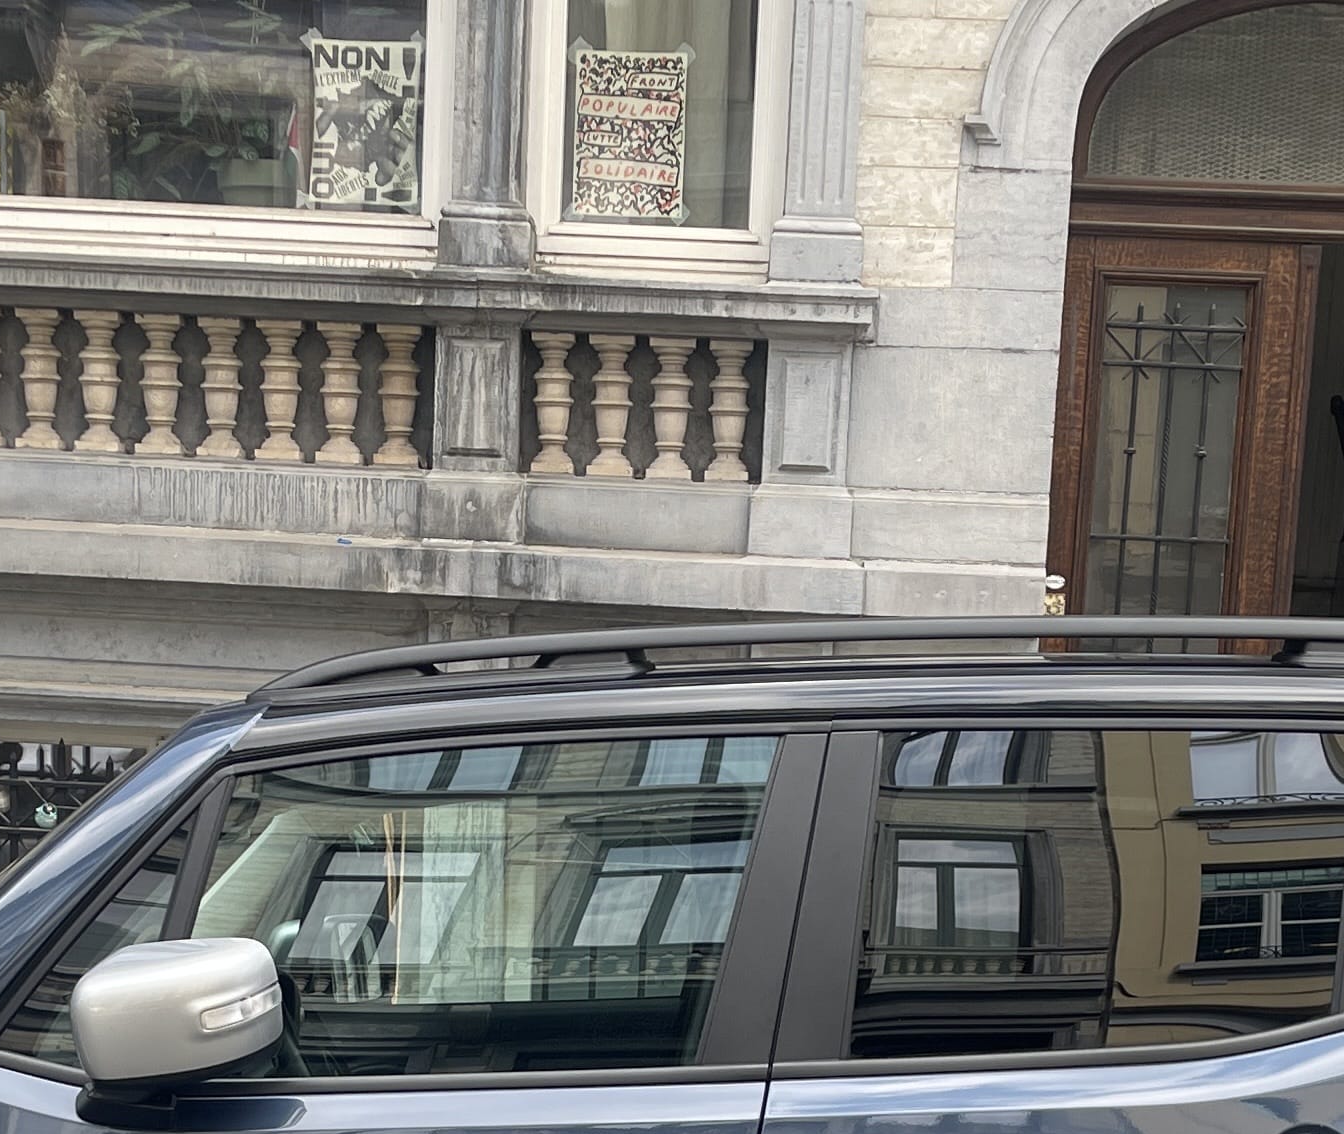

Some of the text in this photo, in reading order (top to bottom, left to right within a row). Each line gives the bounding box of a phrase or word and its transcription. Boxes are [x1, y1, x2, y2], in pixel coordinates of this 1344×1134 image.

[314, 44, 390, 71] NON
[630, 76, 675, 87] FRONT
[580, 98, 679, 117] POPULAIRE
[586, 133, 619, 145] LUTTE
[311, 142, 335, 199] OUI
[331, 167, 348, 186] AUX
